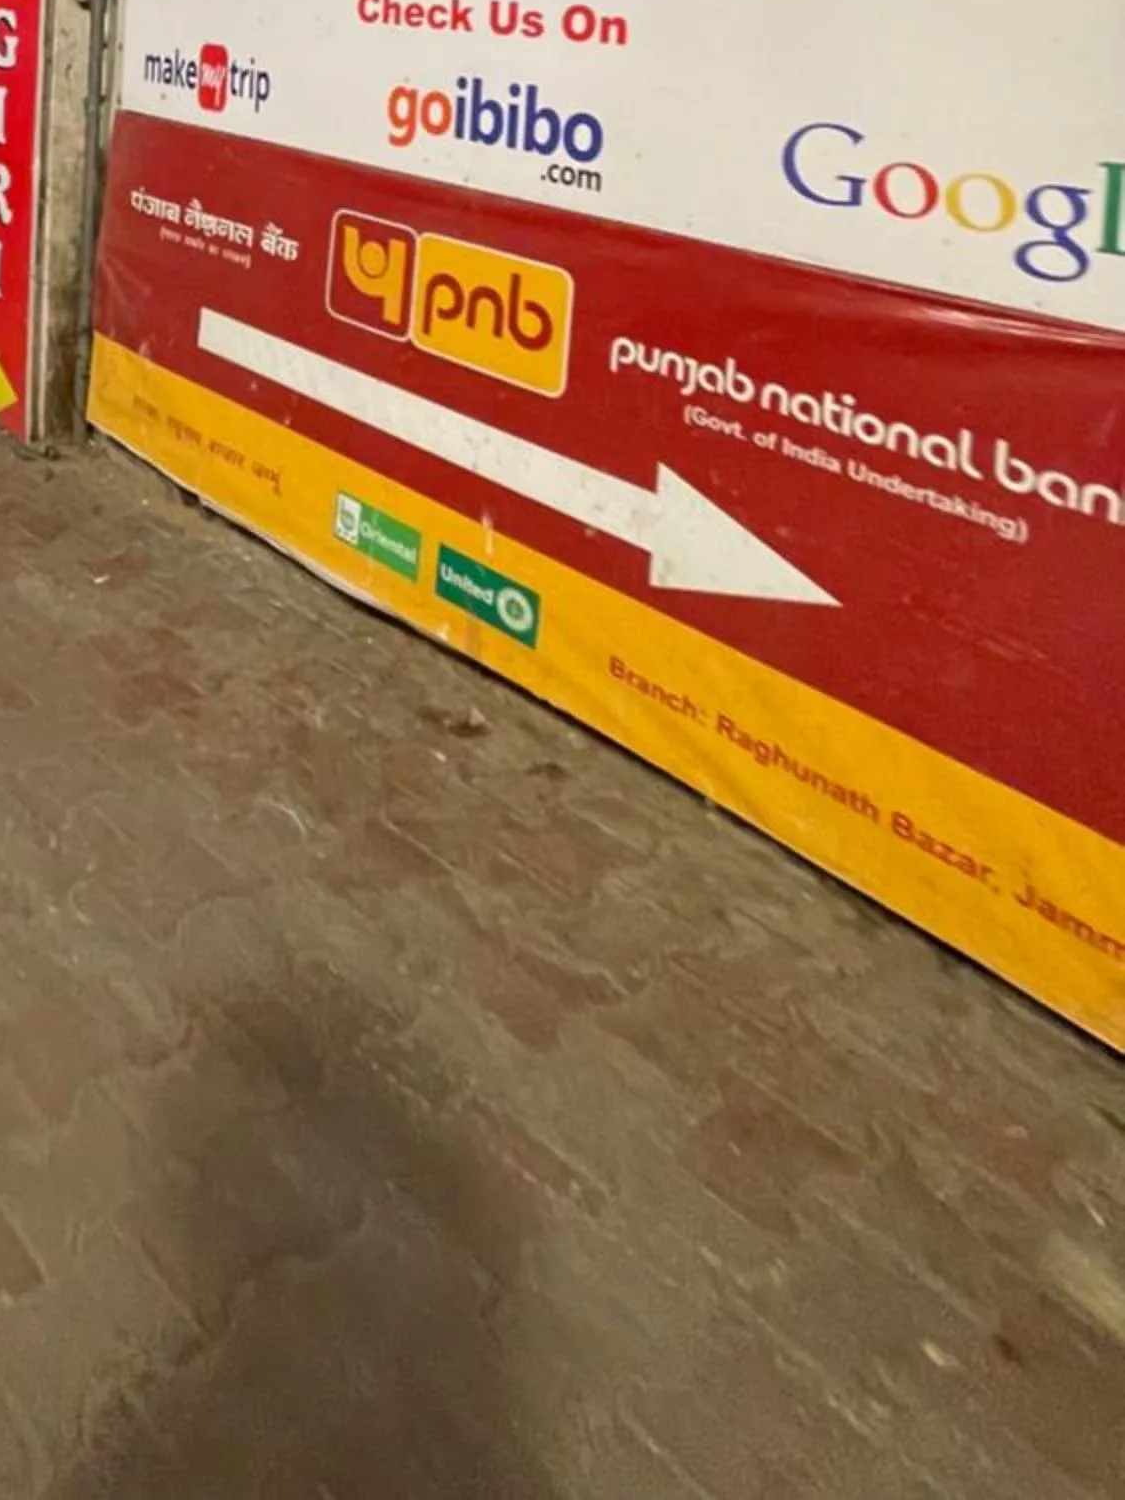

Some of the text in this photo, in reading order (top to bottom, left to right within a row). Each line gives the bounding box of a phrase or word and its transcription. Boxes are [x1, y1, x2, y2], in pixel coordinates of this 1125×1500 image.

[489, 0, 545, 38] Us
[562, 4, 629, 46] On
[387, 77, 604, 163] goibibo
[539, 161, 603, 192] .com
[421, 271, 554, 352] pnb
[609, 336, 1125, 527] punjab national ban
[683, 404, 1029, 545] (Govt. of India Undertaking)
[440, 562, 495, 606] United
[717, 713, 880, 826] Raghunath
